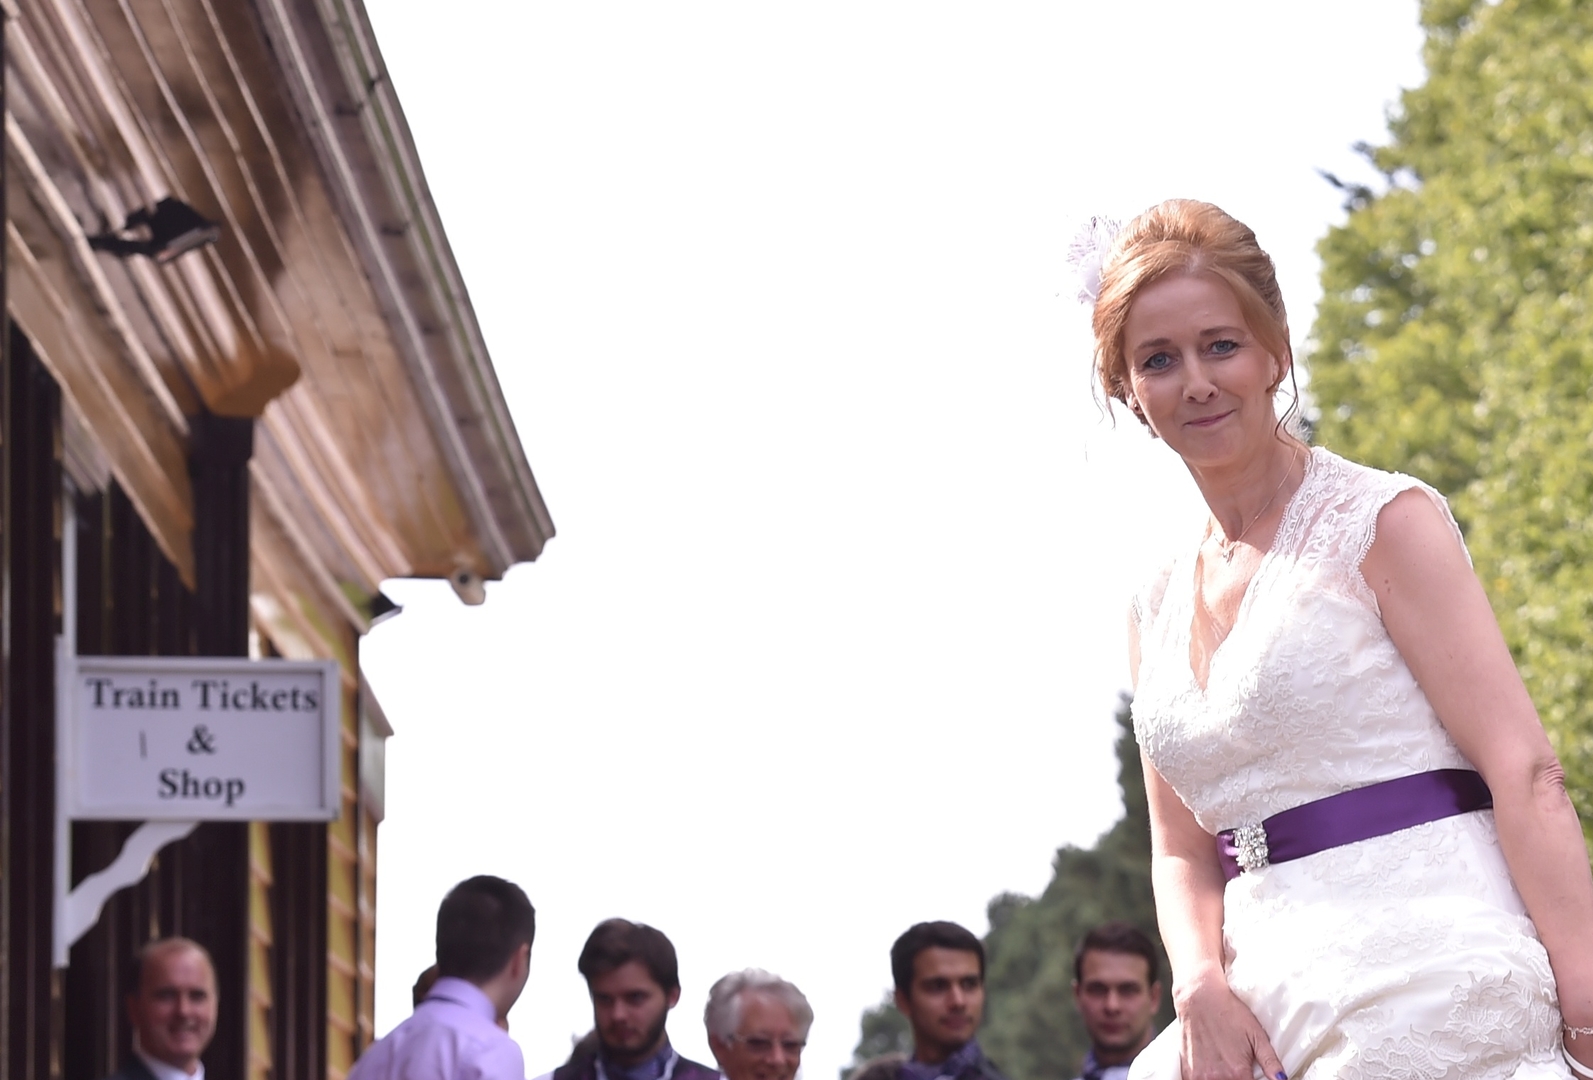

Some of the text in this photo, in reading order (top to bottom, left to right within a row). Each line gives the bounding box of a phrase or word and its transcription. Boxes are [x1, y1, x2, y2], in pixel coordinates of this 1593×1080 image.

[86, 678, 319, 713] Train Tickets
[186, 724, 215, 754] &
[157, 769, 245, 806] Shop
